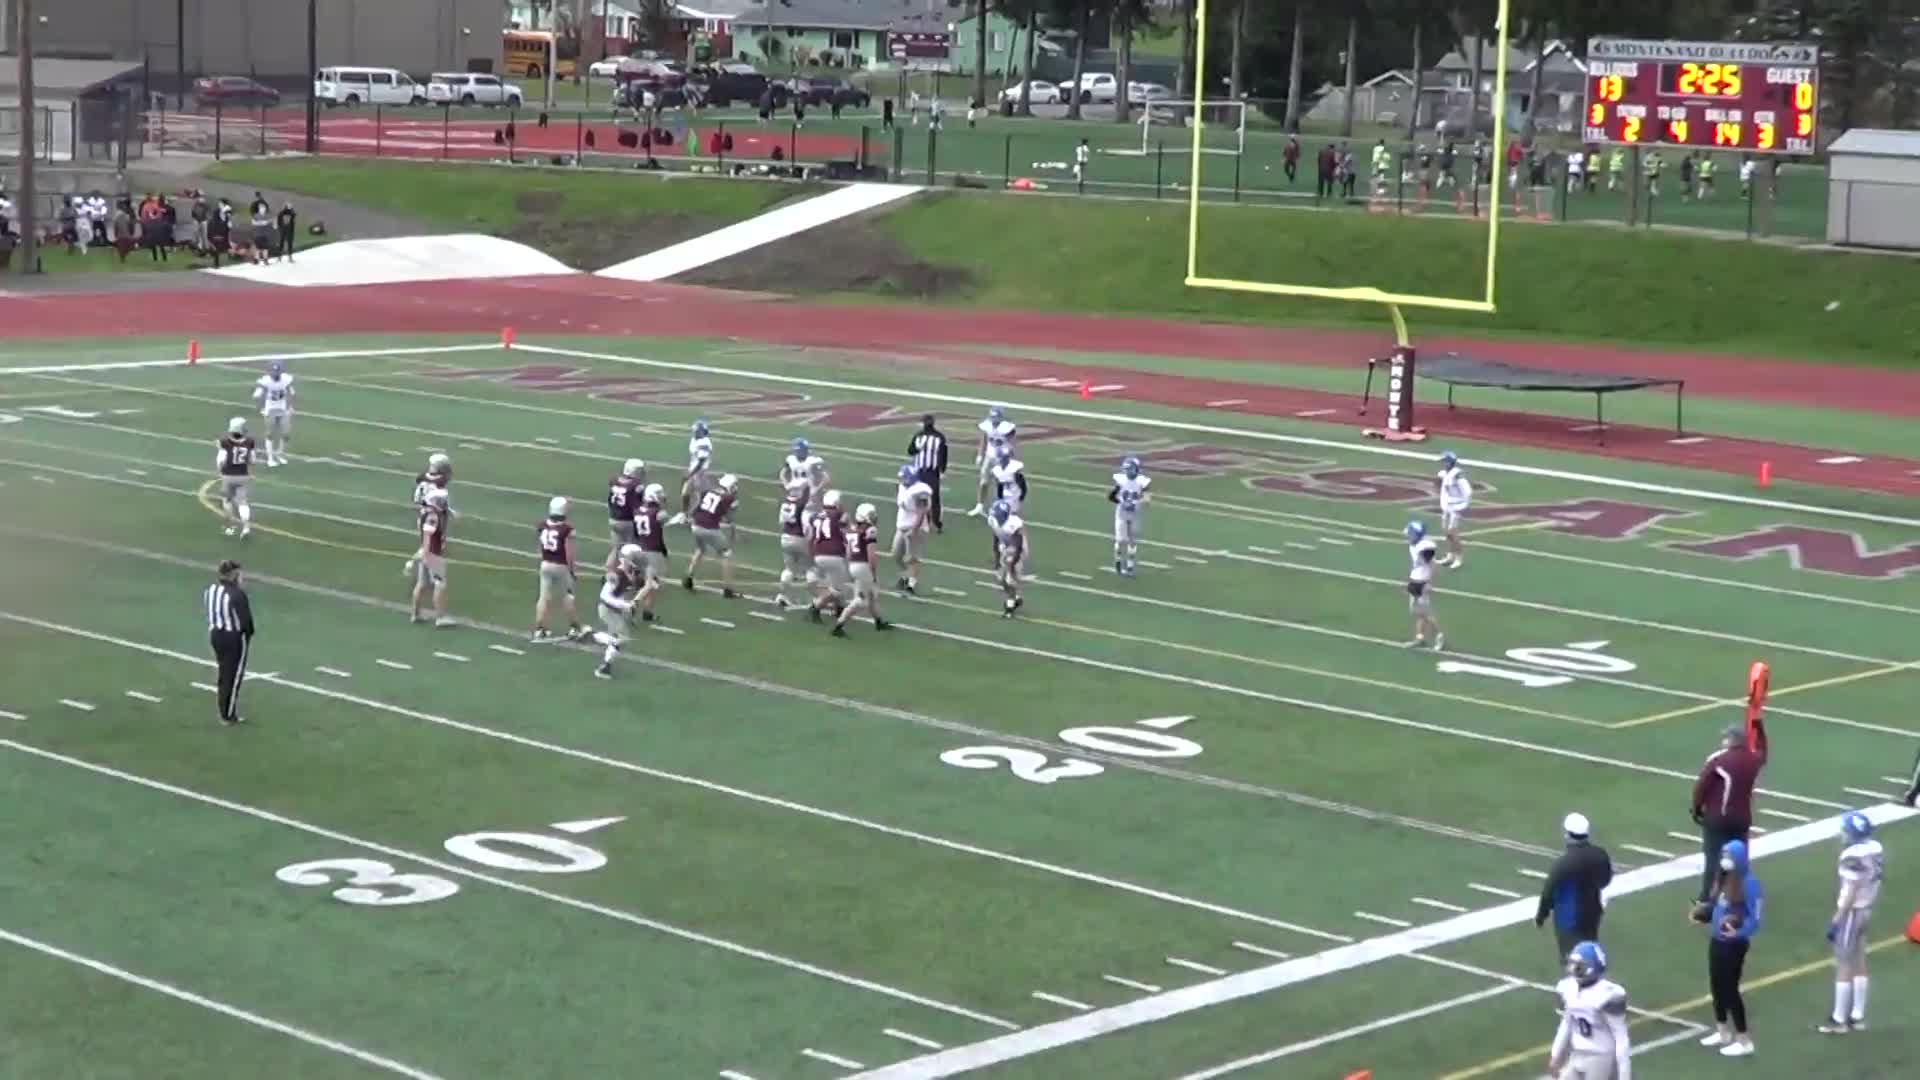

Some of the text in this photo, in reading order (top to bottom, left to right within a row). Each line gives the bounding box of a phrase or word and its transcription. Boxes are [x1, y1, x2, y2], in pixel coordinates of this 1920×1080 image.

[1600, 75, 1622, 101] 13
[1679, 62, 1742, 95] 2:25
[1766, 66, 1811, 85] GUEST
[1795, 82, 1813, 110] 0
[1591, 103, 1604, 125] 3
[1797, 113, 1812, 136] 3
[1624, 116, 1640, 142] 2
[1670, 120, 1687, 143] 4
[1716, 122, 1740, 145] 14
[1757, 122, 1774, 149] 3
[232, 446, 248, 465] 12
[540, 528, 559, 552] 45
[1436, 647, 1638, 687] 10
[939, 726, 1204, 783] 20
[275, 832, 608, 906] 30
